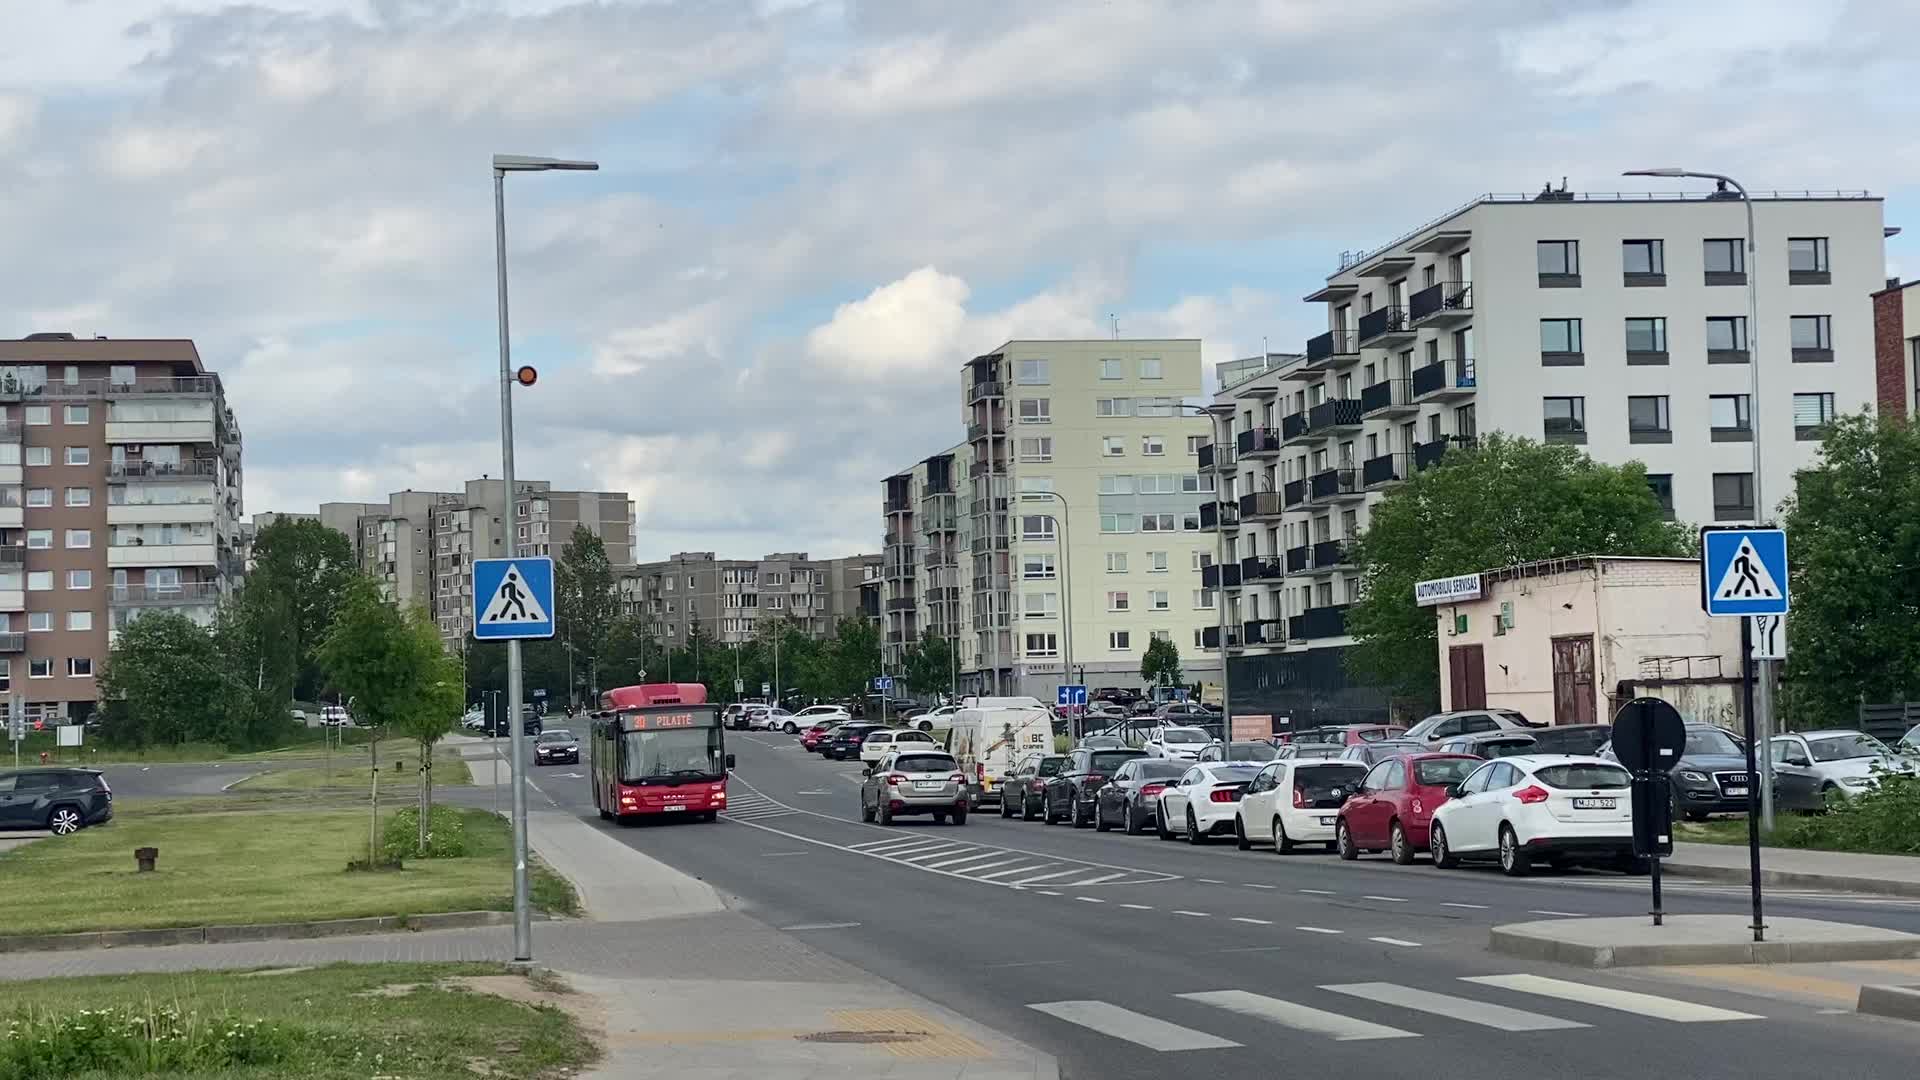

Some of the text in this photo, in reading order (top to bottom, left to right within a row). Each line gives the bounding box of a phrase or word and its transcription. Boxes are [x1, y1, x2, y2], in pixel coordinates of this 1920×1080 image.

[1453, 576, 1478, 592] SERVISAS
[1031, 733, 1044, 743] BC
[1600, 799, 1614, 807] 522
